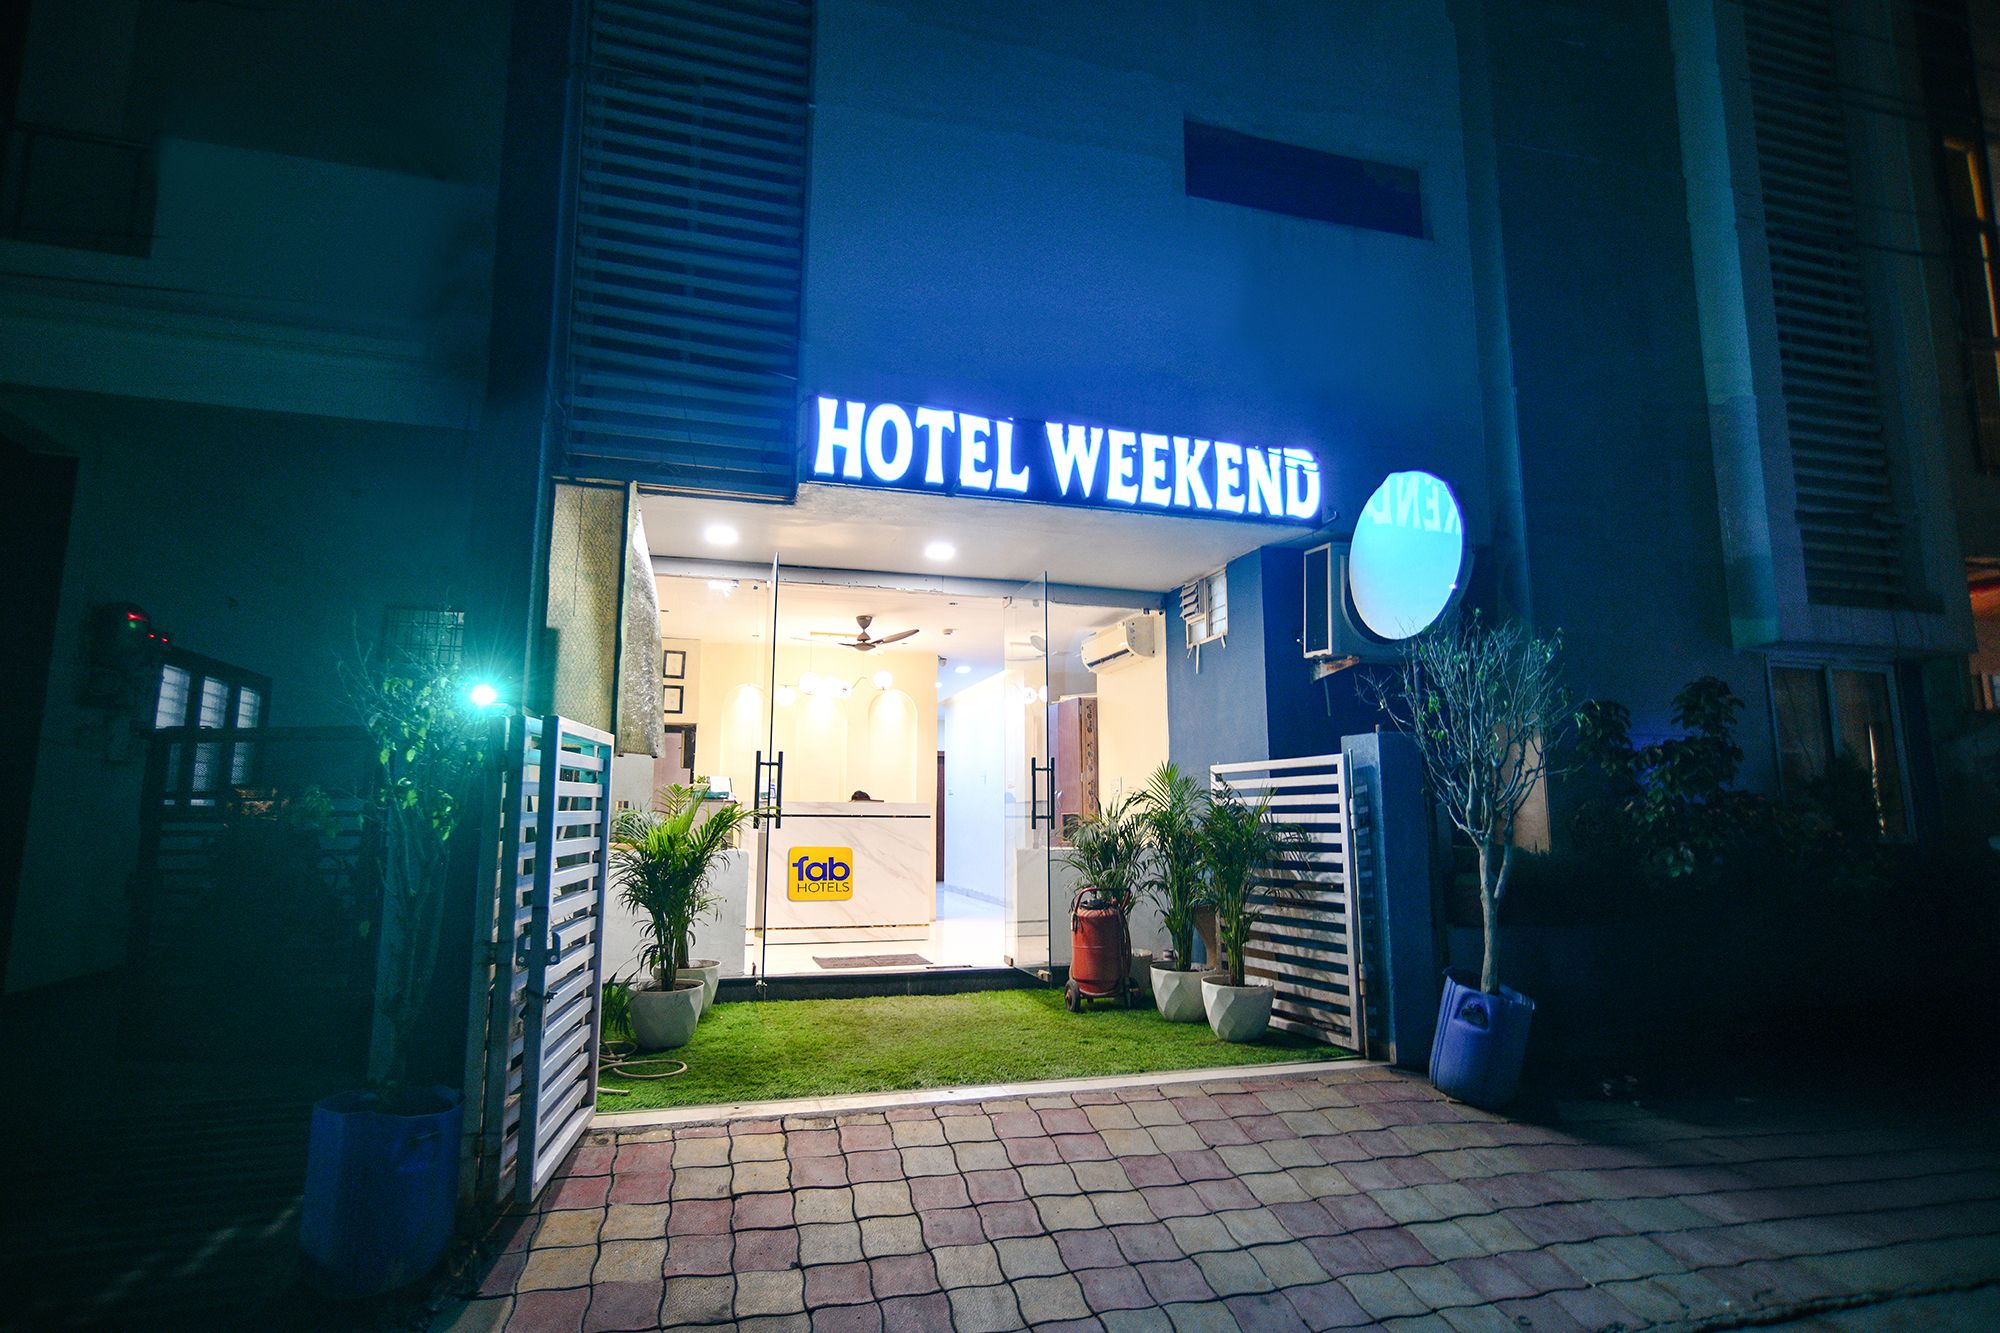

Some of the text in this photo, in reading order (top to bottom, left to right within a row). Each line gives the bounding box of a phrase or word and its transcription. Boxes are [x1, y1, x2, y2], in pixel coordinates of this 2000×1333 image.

[814, 396, 1321, 519] HOTEL WEEKEND
[792, 856, 850, 881] fab
[797, 882, 850, 893] HOTELS
